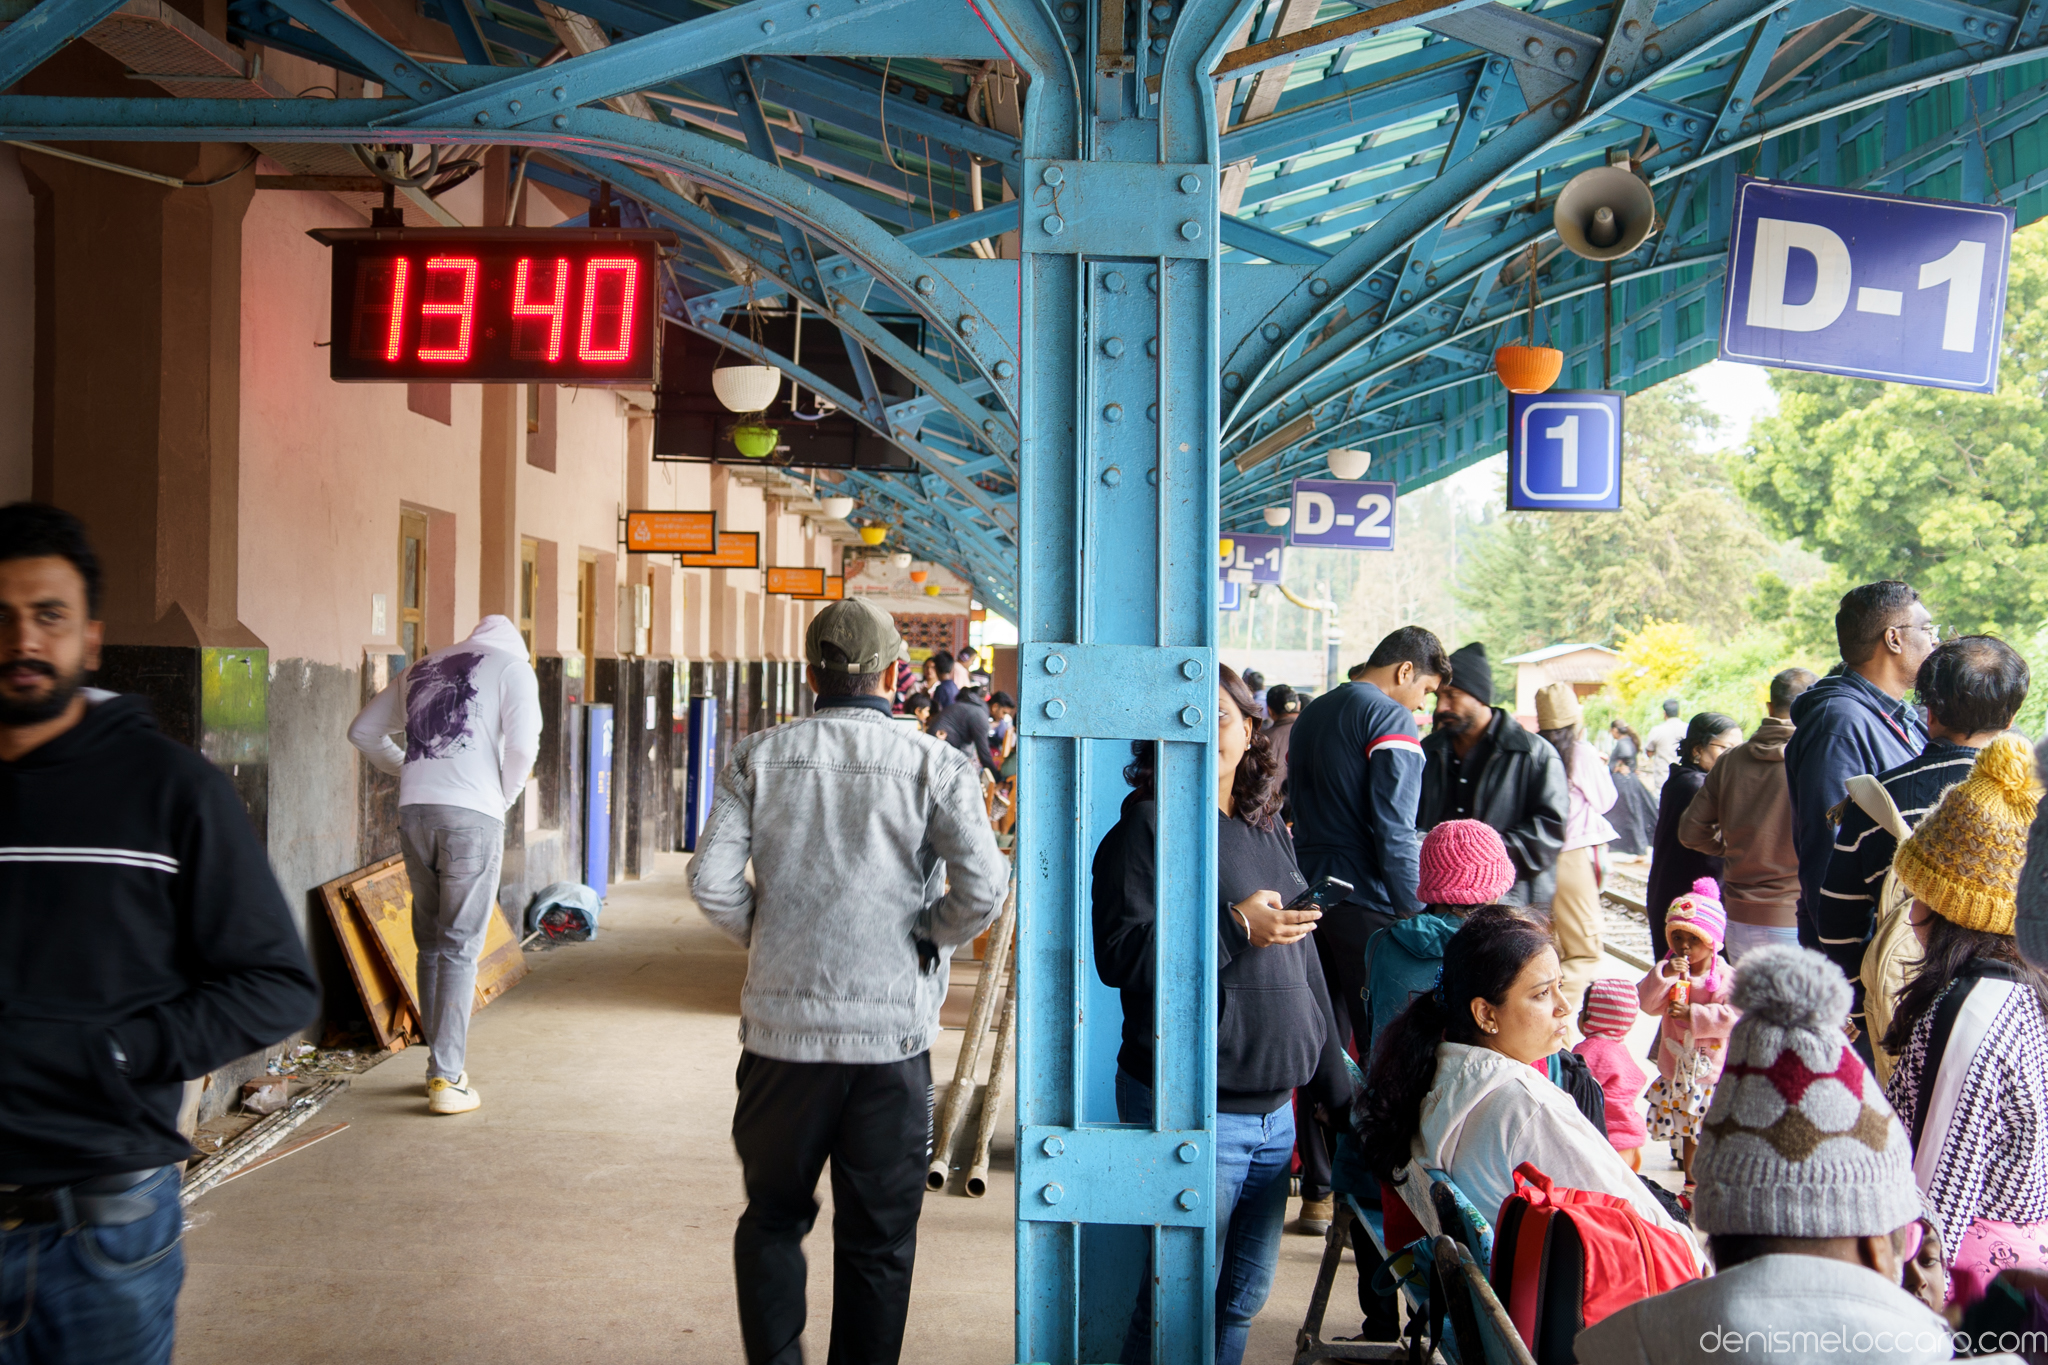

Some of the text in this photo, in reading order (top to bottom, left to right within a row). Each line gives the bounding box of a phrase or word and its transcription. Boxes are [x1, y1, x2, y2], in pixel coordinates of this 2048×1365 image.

[1746, 216, 1986, 353] D-1
[1545, 415, 1579, 488] 1
[1294, 490, 1392, 539] D-2
